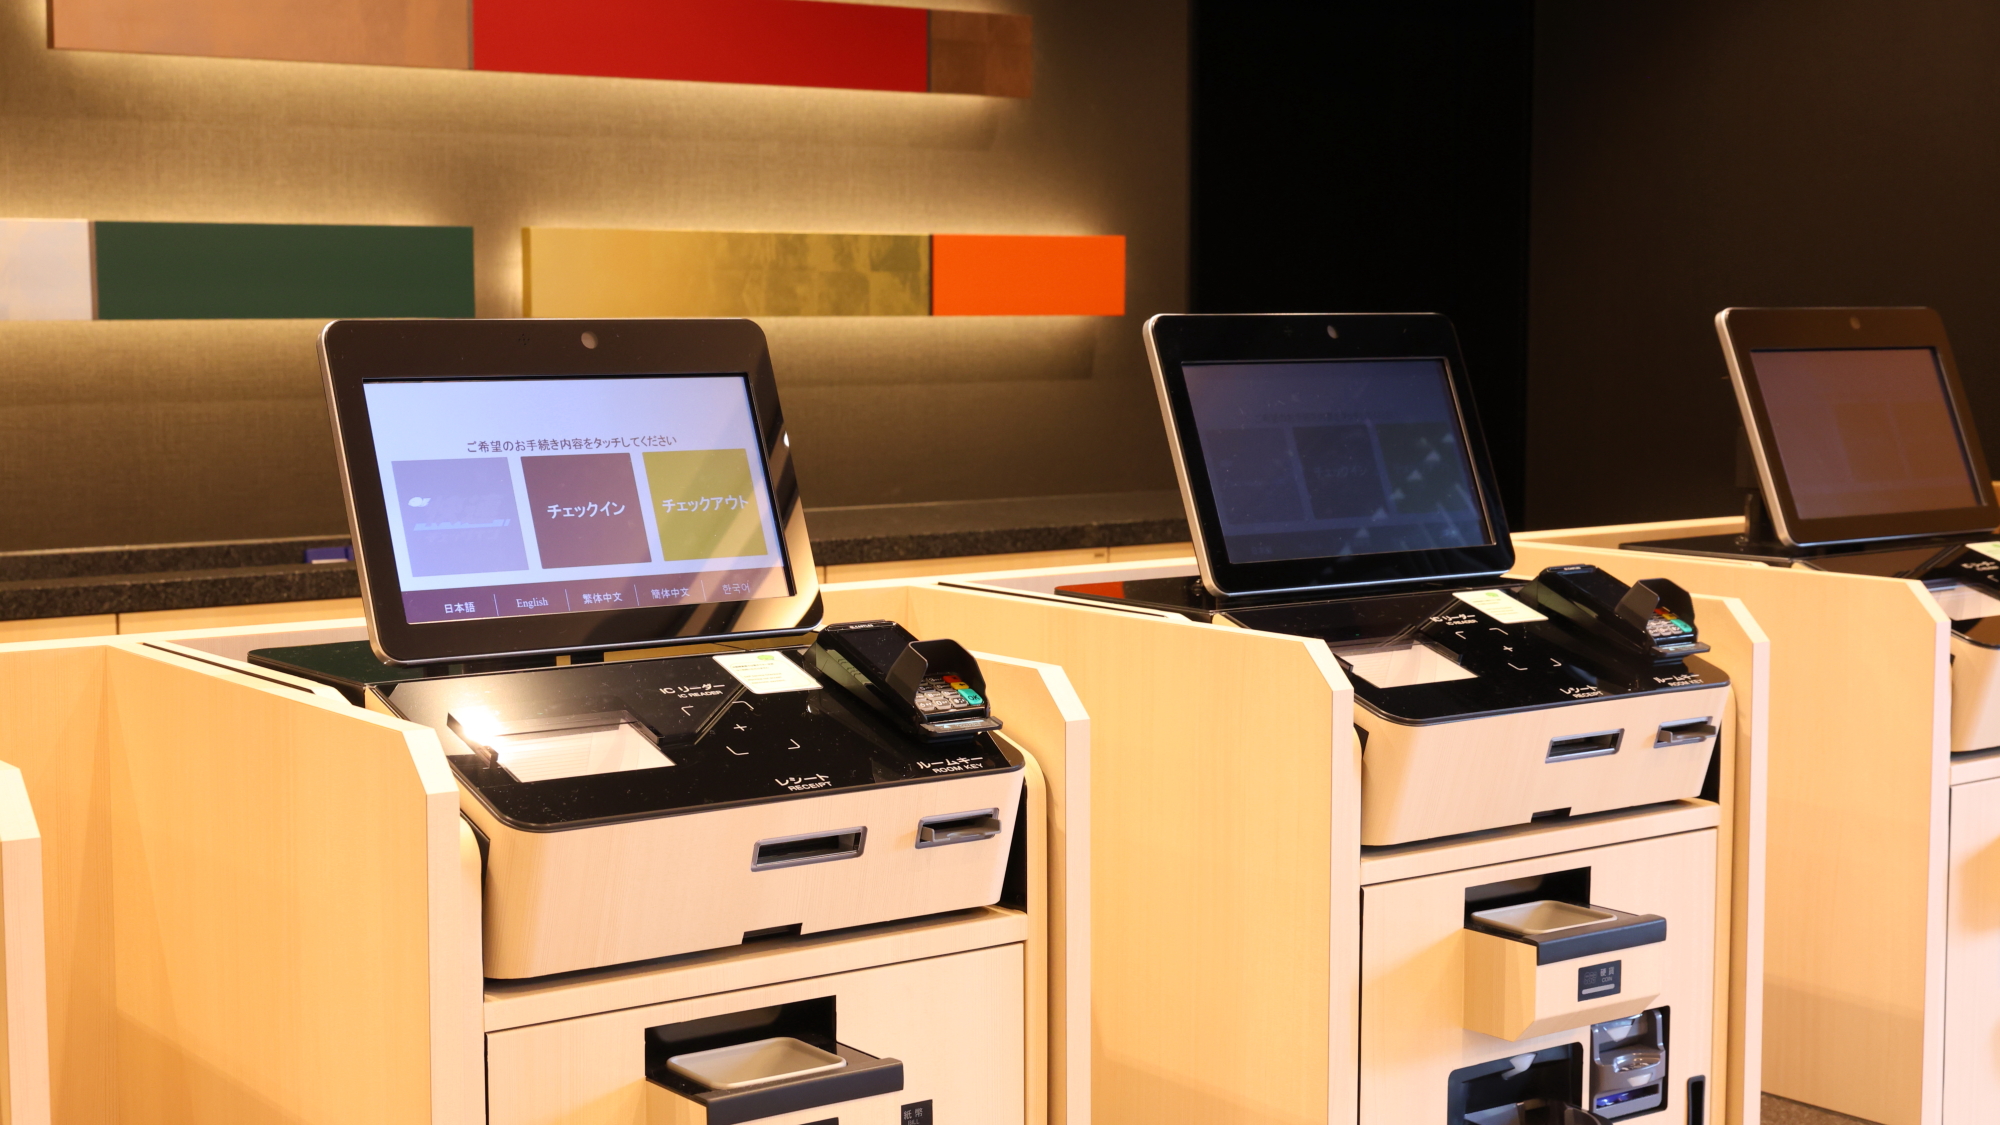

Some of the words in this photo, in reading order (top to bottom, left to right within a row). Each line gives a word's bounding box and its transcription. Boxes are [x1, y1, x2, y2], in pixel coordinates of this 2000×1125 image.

[466, 434, 678, 453] ご希望のお手続き内容をタッチしてください
[546, 501, 626, 519] チェックイン
[661, 494, 749, 513] チェックアウト
[650, 587, 690, 600] 簡体中文
[722, 579, 751, 595] 한국어
[515, 597, 549, 610] English
[582, 591, 623, 605] 繁体中文
[444, 601, 476, 614] 日本語
[659, 687, 676, 695] IC
[677, 683, 725, 693] リーダー
[688, 690, 724, 698] READER
[916, 757, 984, 769] ルームキー
[932, 766, 964, 774] ROOM
[774, 773, 829, 786] レシート
[787, 780, 833, 791] RECEIPT
